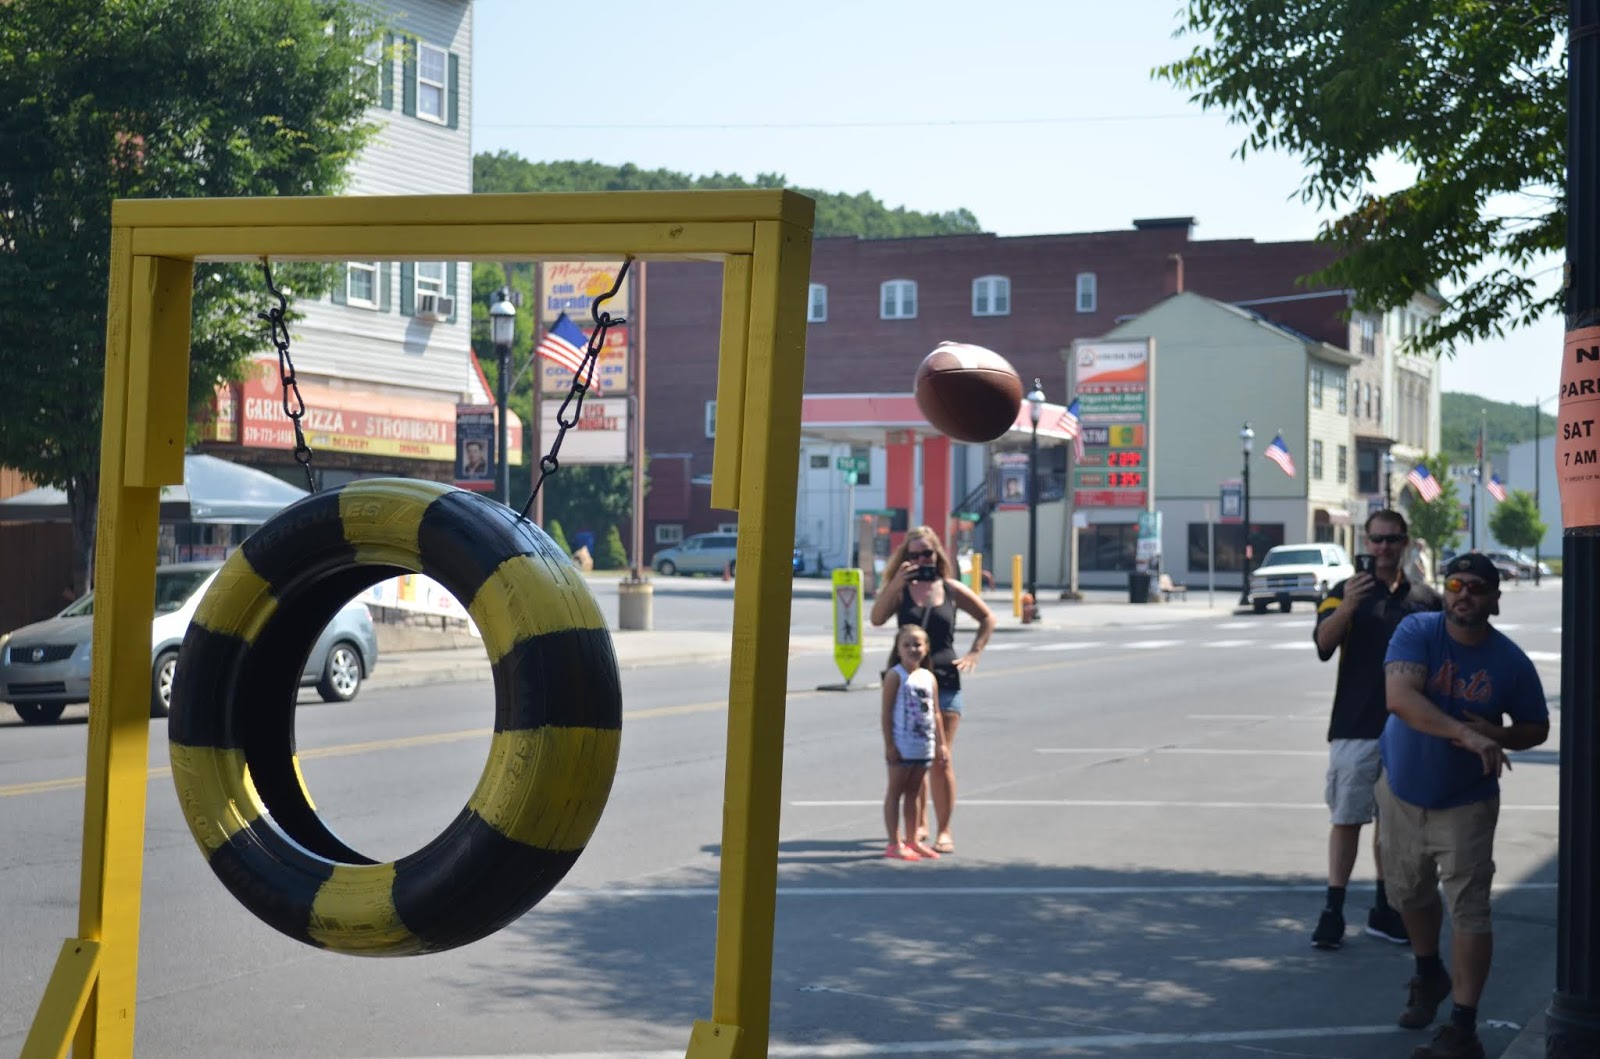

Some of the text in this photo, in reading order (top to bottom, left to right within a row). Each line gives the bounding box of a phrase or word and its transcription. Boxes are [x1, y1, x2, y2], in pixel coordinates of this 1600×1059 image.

[1561, 377, 1600, 400] PAR
[302, 408, 345, 432] PIZZA
[365, 416, 447, 443] STROMBOLI
[1563, 420, 1595, 440] SAT
[1564, 449, 1597, 467] 7 AM
